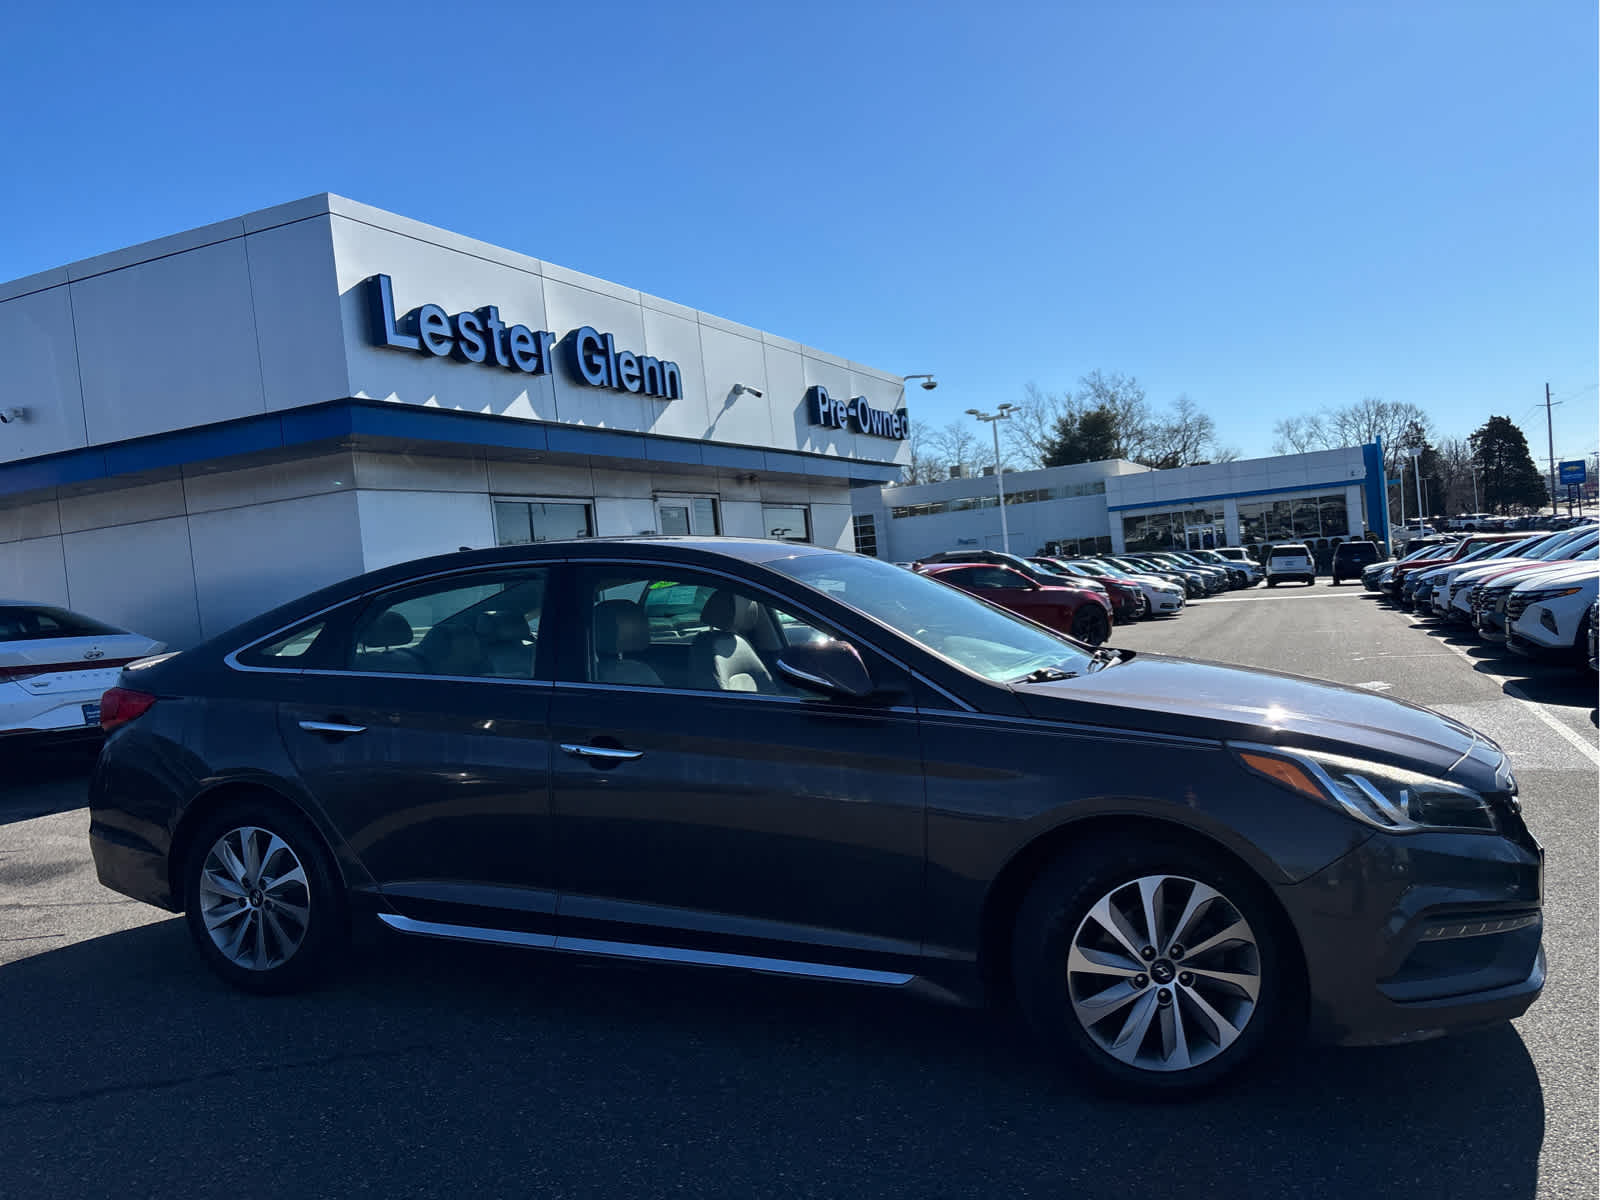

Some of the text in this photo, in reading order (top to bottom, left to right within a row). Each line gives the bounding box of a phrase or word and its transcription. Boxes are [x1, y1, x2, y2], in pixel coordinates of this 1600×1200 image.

[372, 273, 683, 401] Lester Glenn
[811, 385, 911, 441] Pre-Owned
